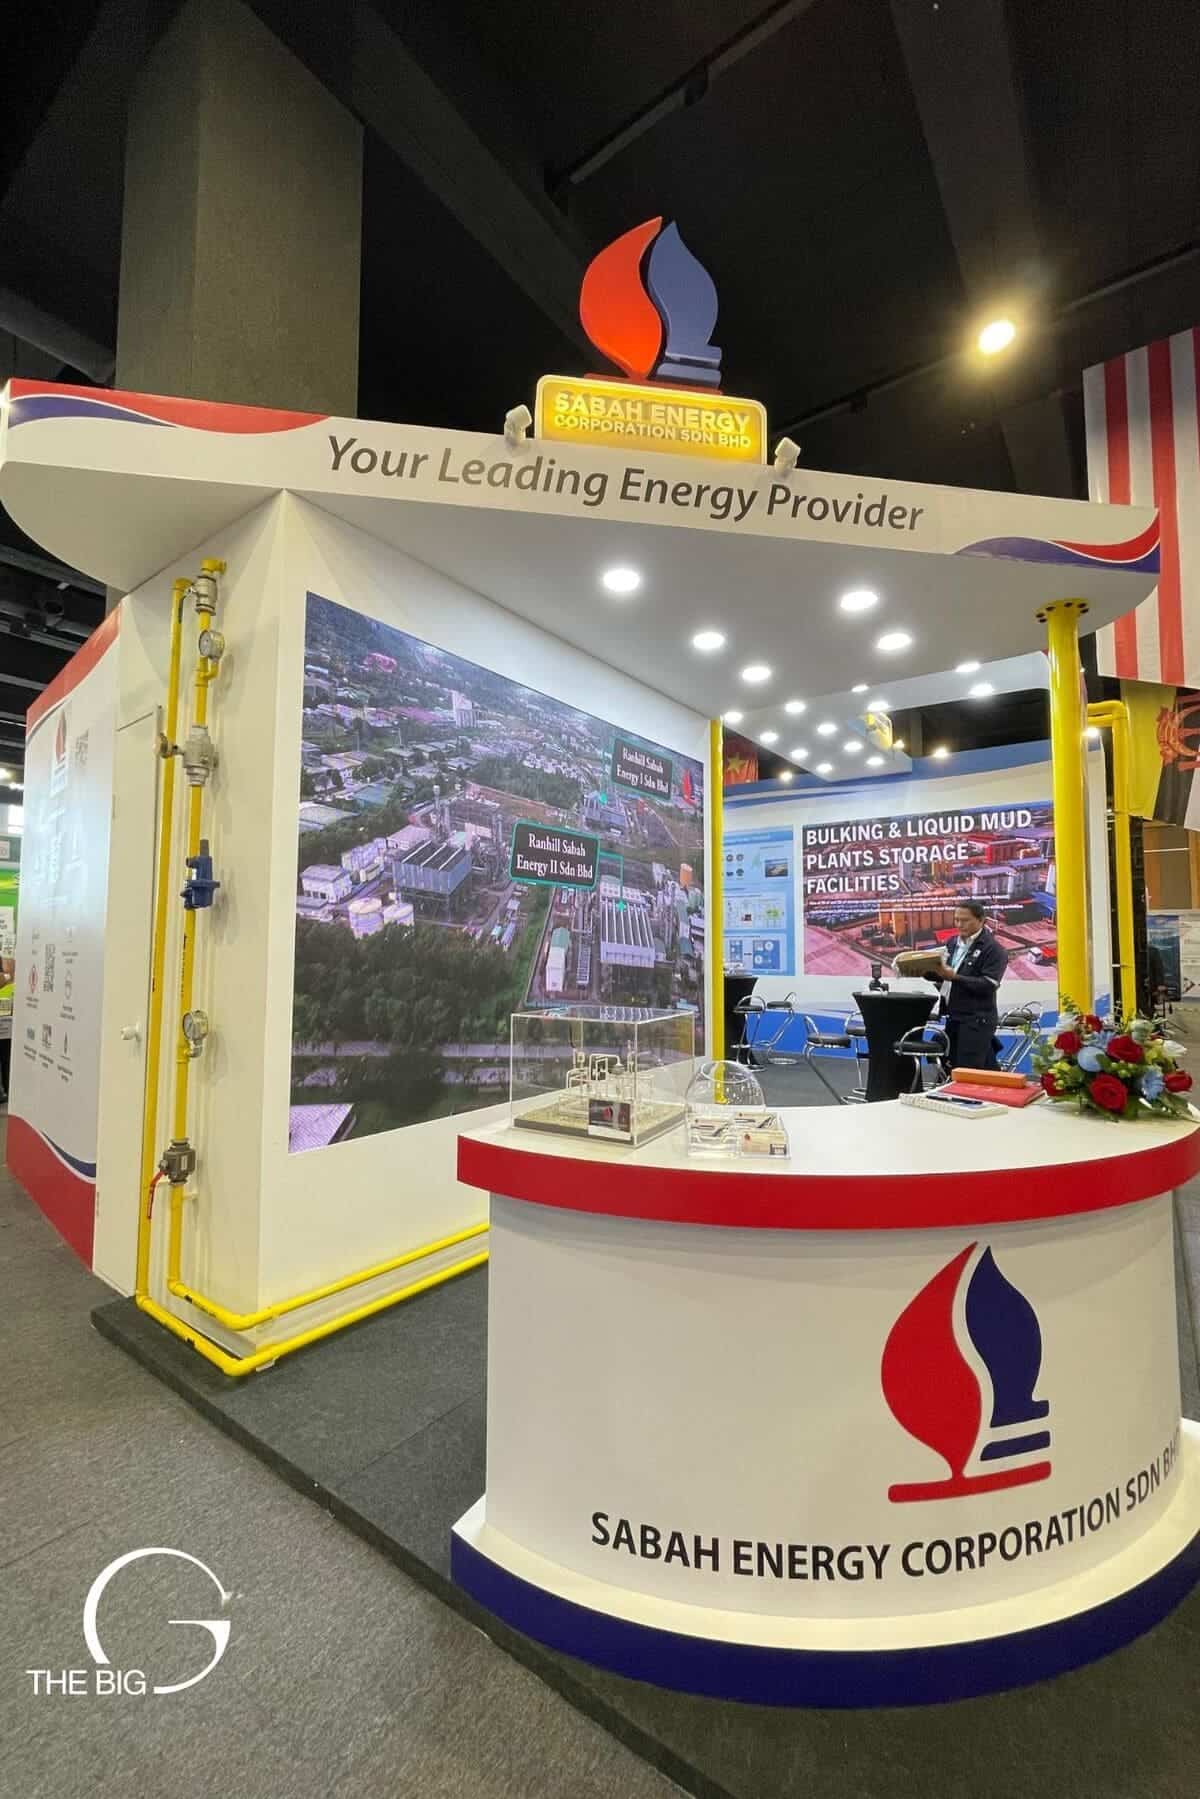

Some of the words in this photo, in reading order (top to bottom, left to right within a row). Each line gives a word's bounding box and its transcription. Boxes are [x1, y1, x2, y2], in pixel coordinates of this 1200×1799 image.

[554, 393, 642, 420] SABAH
[651, 405, 750, 434] ENERGY
[554, 415, 675, 440] CORPORATION
[681, 429, 714, 445] SDN
[719, 434, 752, 449] BHD
[328, 435, 429, 478] Your
[438, 447, 608, 506] Leading
[620, 467, 759, 522] Energy
[766, 483, 925, 532] Provider
[622, 747, 645, 767] Ranhill
[616, 764, 640, 787] Energy
[644, 774, 656, 789] Sdn
[656, 778, 669, 793] Bhd
[806, 823, 884, 846] BULKING
[889, 822, 902, 839] &
[907, 815, 975, 837] LIQUID
[981, 809, 1033, 831] MUD
[528, 832, 561, 853] Ranhill
[561, 840, 586, 857] Sabah
[806, 851, 874, 870] PLANTS
[879, 842, 970, 864] STORAGE
[516, 854, 548, 877] Energy
[560, 862, 576, 877] Sdn
[577, 863, 593, 879] Bhd
[806, 874, 900, 895] FACILITIES
[591, 1511, 720, 1572] SABAH
[732, 1540, 891, 1581] ENERGY
[901, 1487, 1121, 1577] CORPORATION
[1126, 1456, 1160, 1512] SDN
[1162, 1425, 1180, 1480] BH
